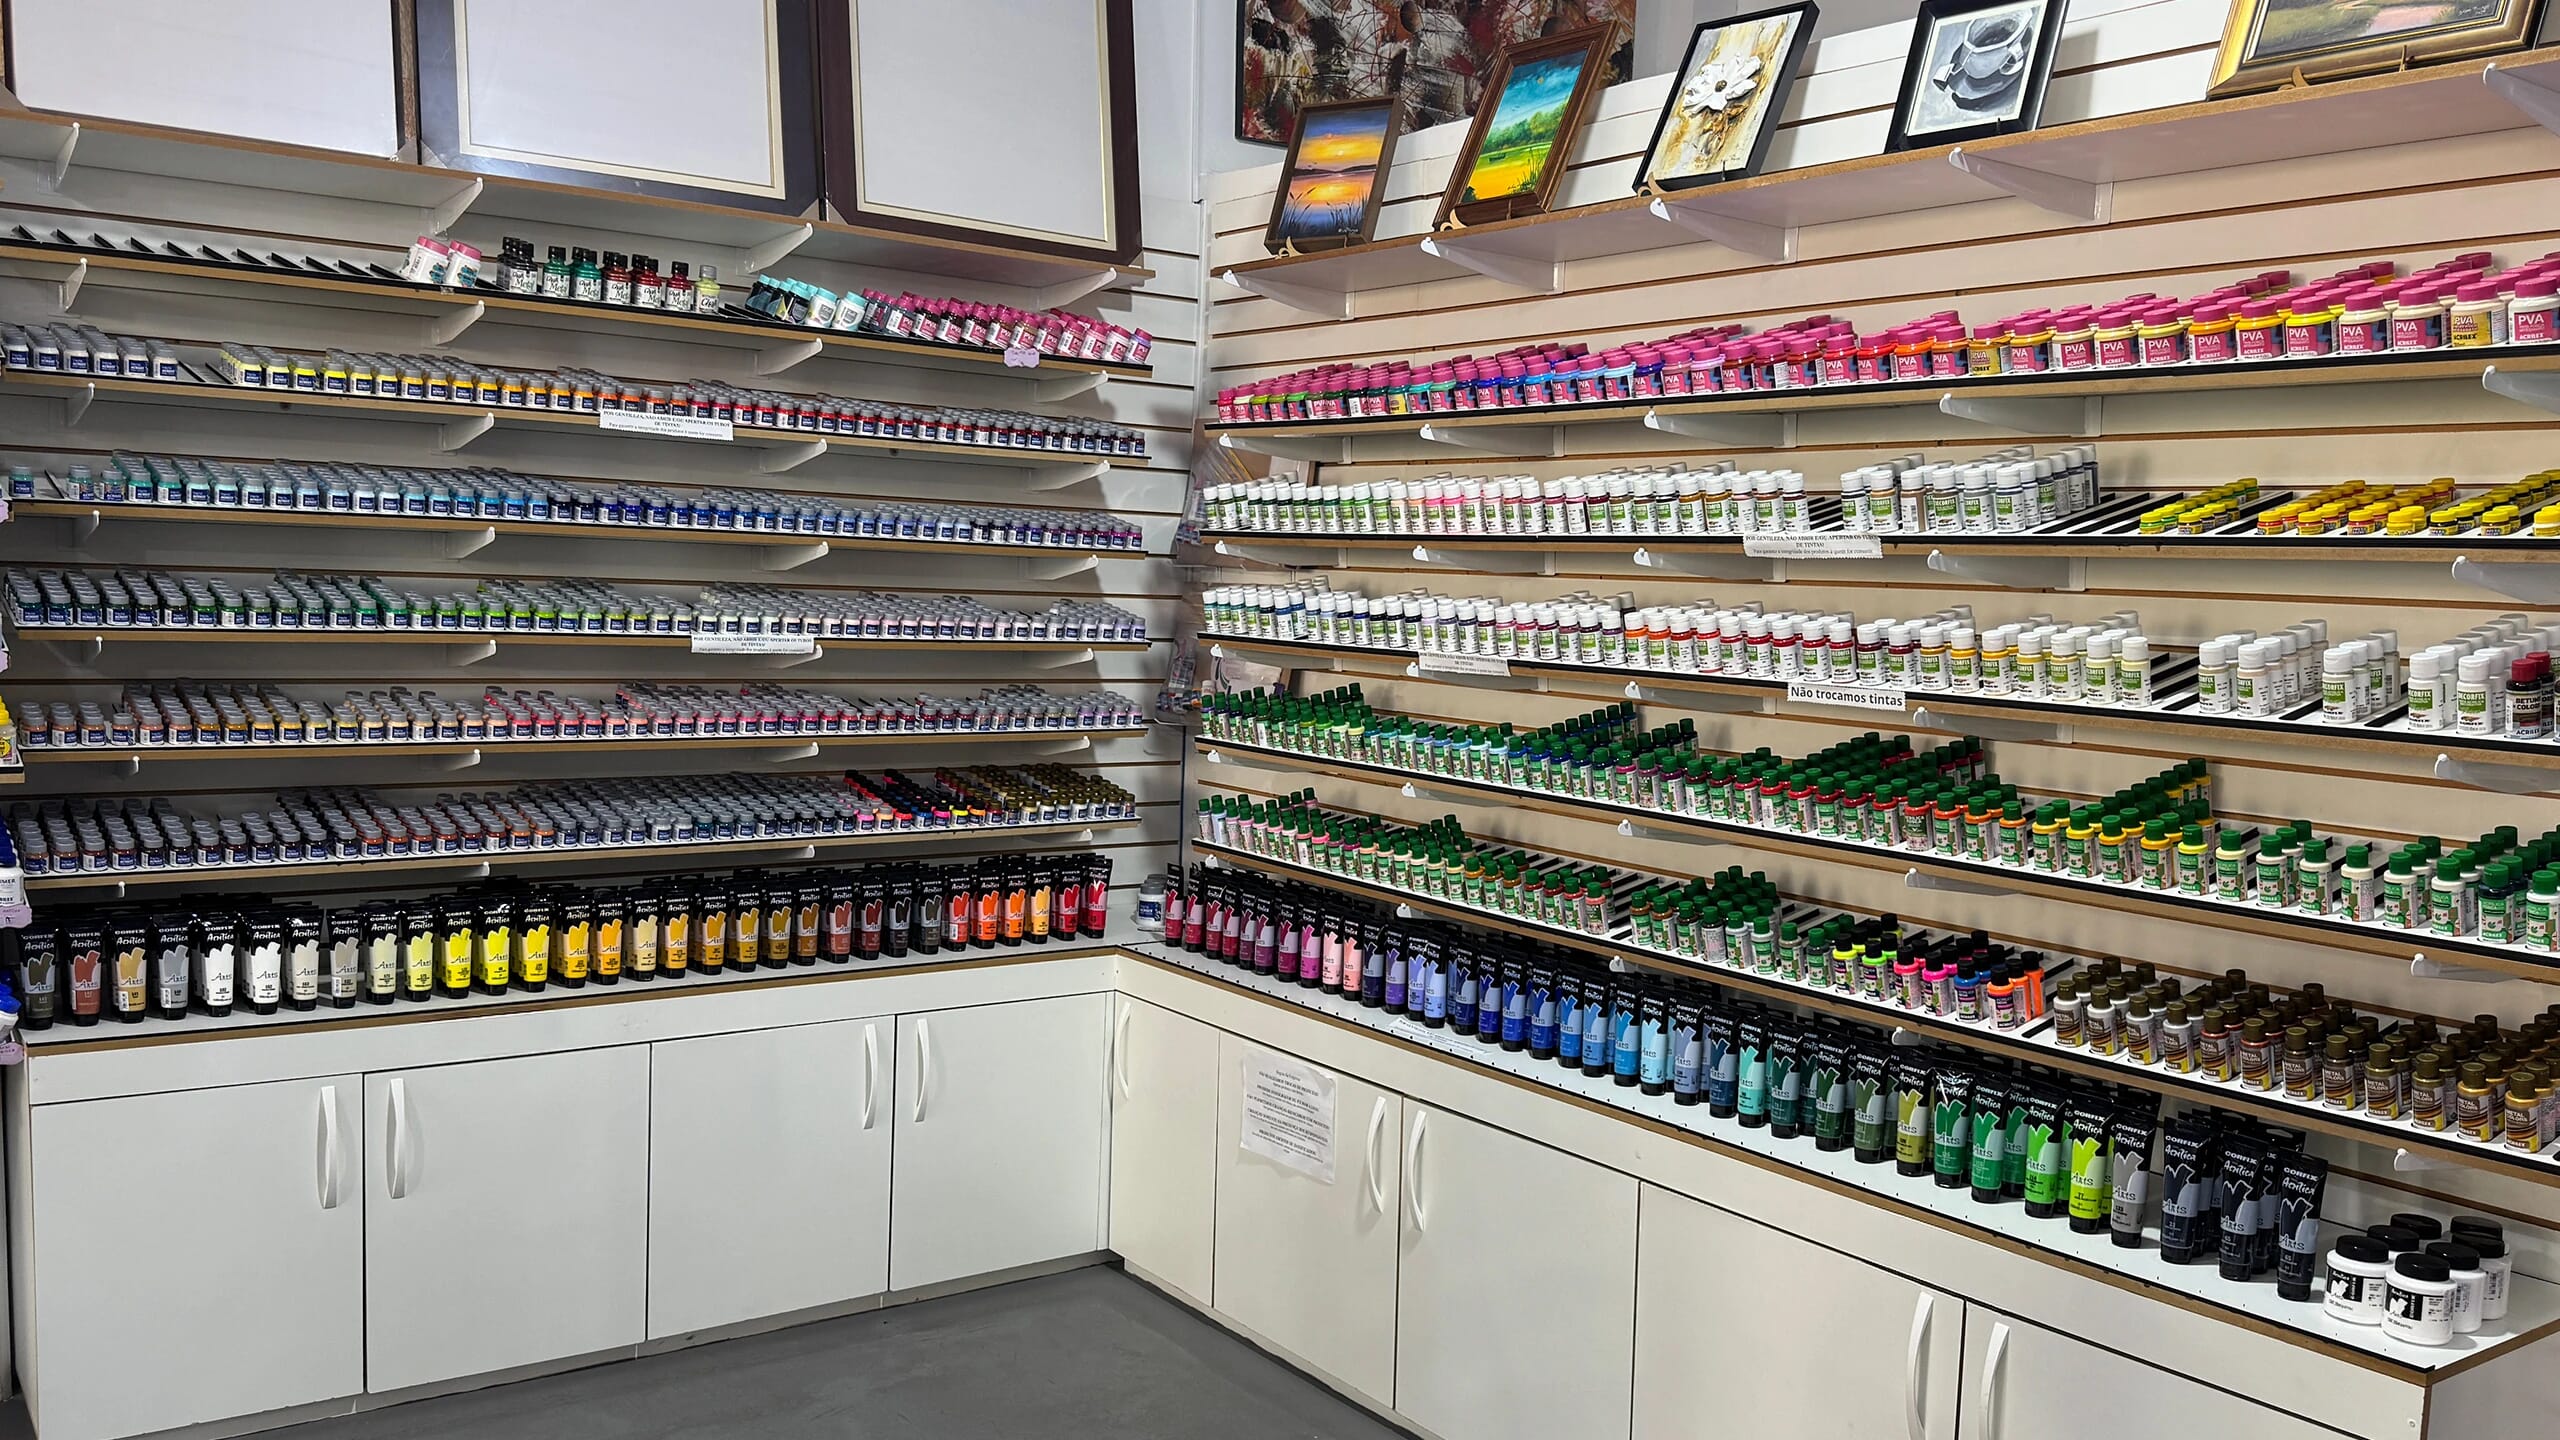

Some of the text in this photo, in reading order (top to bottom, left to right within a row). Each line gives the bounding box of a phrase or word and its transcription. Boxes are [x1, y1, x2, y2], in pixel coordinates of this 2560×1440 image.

[2454, 316, 2473, 325] PVA
[2518, 313, 2544, 326] PVA
[2342, 326, 2364, 337] PVA
[2396, 321, 2417, 332] PVA
[2242, 331, 2264, 342] PVA
[2289, 328, 2310, 339] PVA
[2102, 340, 2124, 351] PVA
[2148, 339, 2170, 350] PVA
[2198, 335, 2220, 346] PVA
[2012, 348, 2028, 358] PVA
[2065, 343, 2086, 354] PVA
[1791, 686, 1902, 706] Não trocamos tintas
[211, 972, 233, 982] Arts
[256, 970, 278, 980] Arts
[1774, 1032, 1799, 1044] CORFIX
[1818, 1043, 1844, 1054] CORFIX
[1857, 1053, 1884, 1065] CORFIX
[1900, 1064, 1927, 1076] CORFIX
[1772, 1085, 1790, 1099] Arts
[1976, 1084, 2003, 1098] CORFIX
[1816, 1096, 1835, 1111] Arts
[2030, 1097, 2058, 1110] CORFIX
[1854, 1108, 1875, 1122] Arts
[2074, 1109, 2106, 1122] CORFIX
[1897, 1120, 1918, 1134] Arts
[2116, 1122, 2148, 1136] CORFIX
[1936, 1132, 1961, 1146] Arts
[2164, 1134, 2199, 1148] CORFIX
[1972, 1144, 1993, 1158] Arts
[2224, 1150, 2258, 1165] CORFIX
[2026, 1158, 2046, 1172] Arts
[2070, 1172, 2094, 1186] Arts
[2283, 1166, 2320, 1182] CORFIX
[2112, 1186, 2136, 1202] Arts
[2162, 1198, 2188, 1216] Arts
[2220, 1215, 2245, 1232] Arts
[2279, 1234, 2305, 1251] Arts
